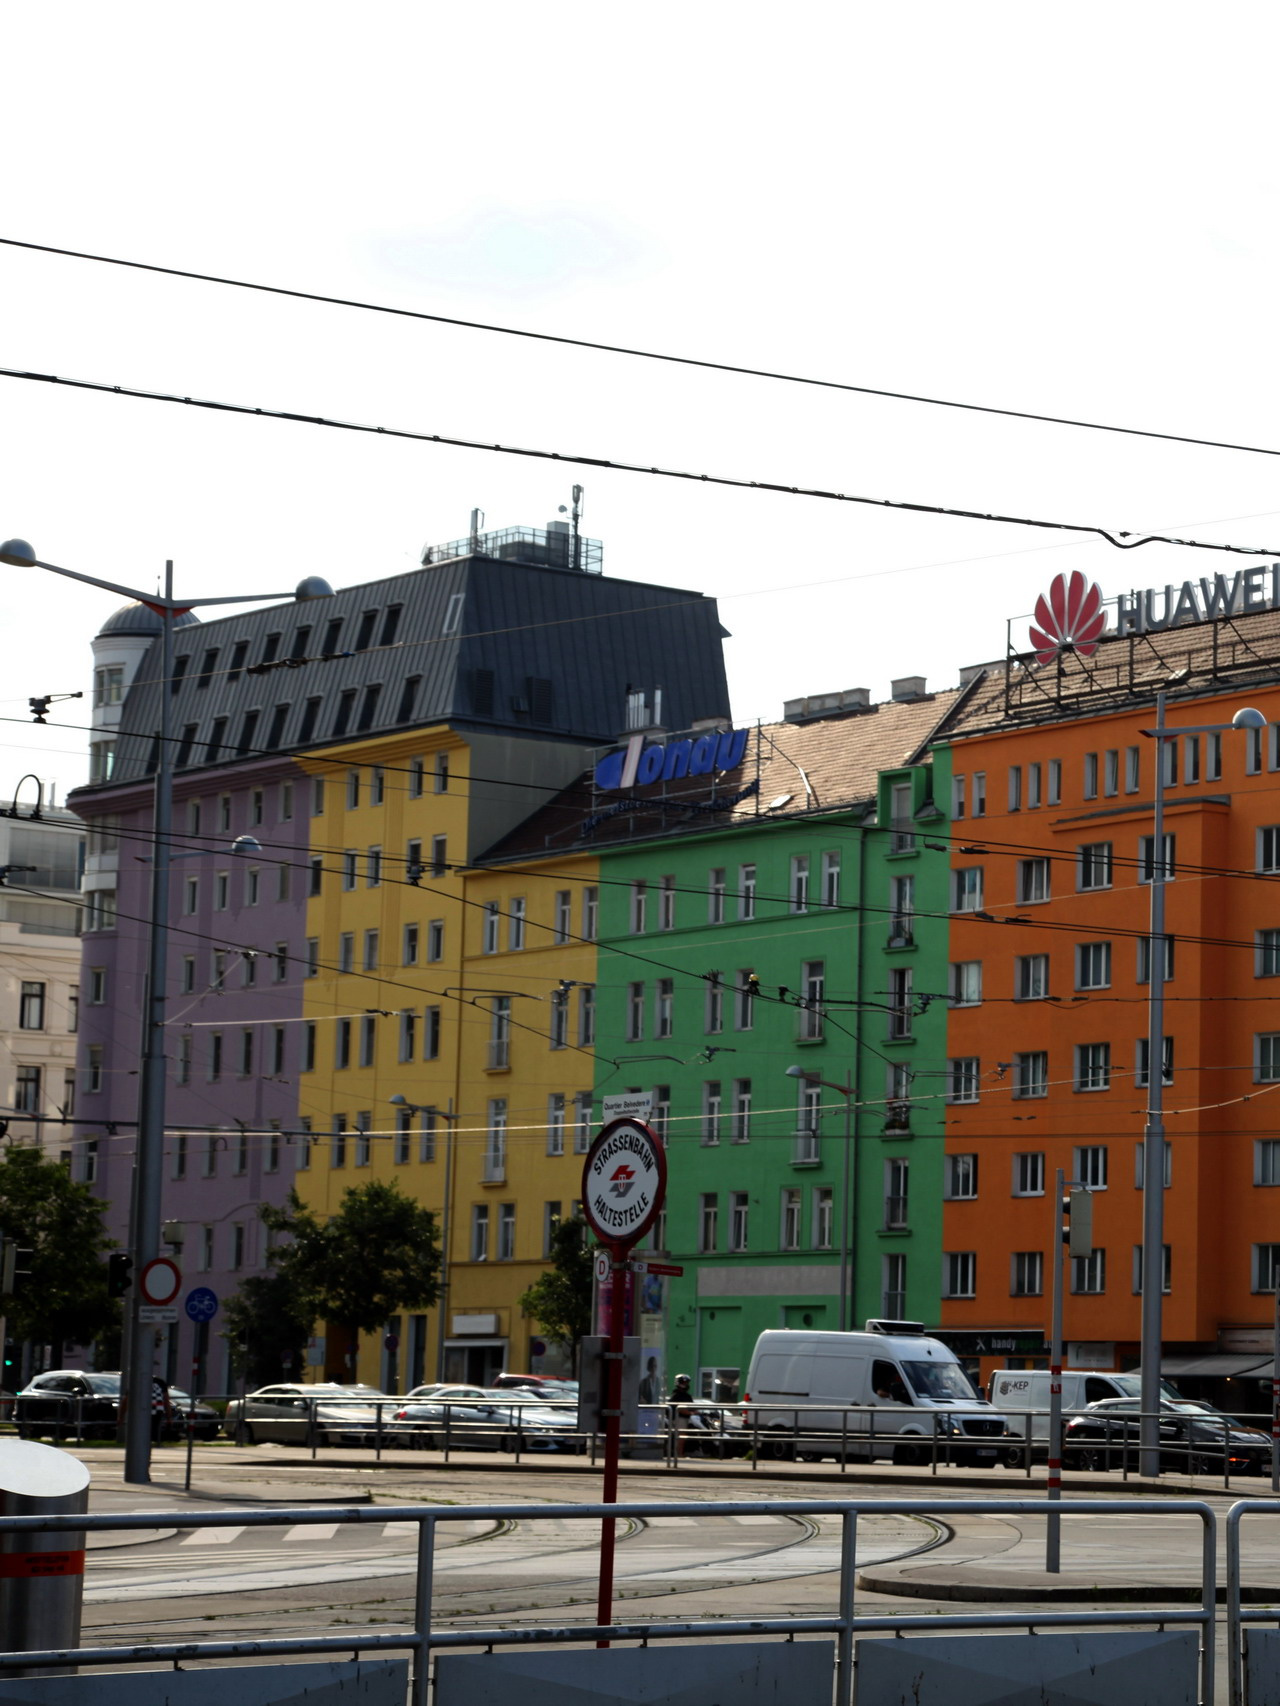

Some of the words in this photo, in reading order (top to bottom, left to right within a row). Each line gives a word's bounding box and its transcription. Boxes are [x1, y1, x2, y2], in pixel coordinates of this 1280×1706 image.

[594, 730, 749, 790] donau
[604, 1102, 622, 1110] Quartier
[624, 1100, 646, 1109] Belvedere
[594, 1135, 653, 1175] STRASSENBAHN
[594, 1192, 650, 1227] HALTESTELLE
[599, 1260, 606, 1275] D
